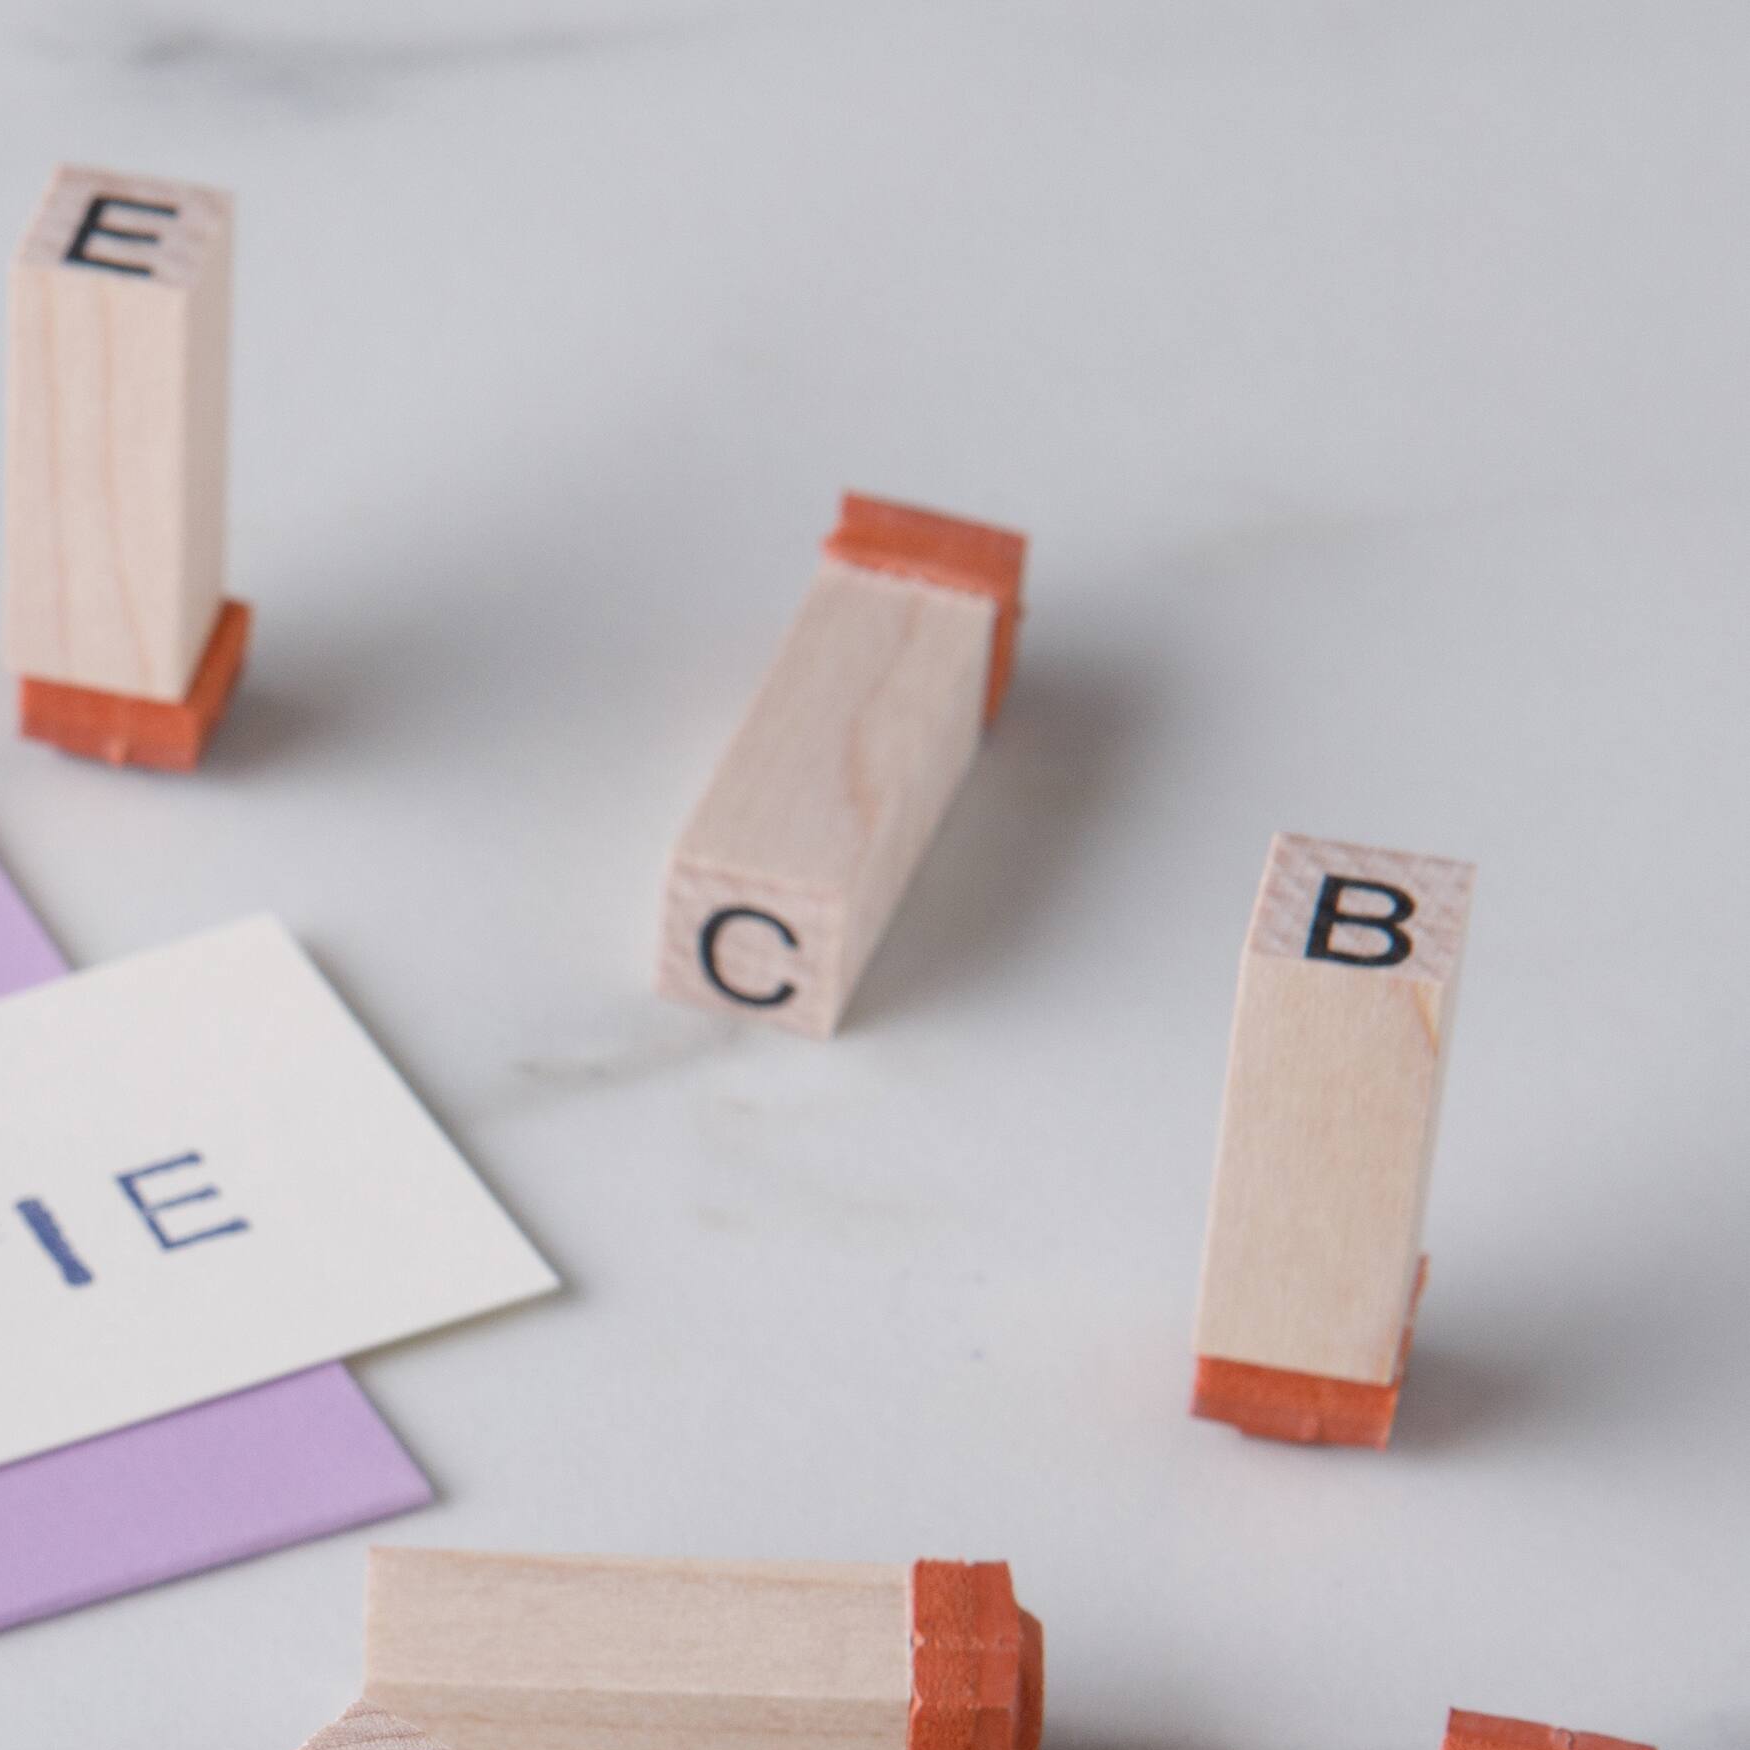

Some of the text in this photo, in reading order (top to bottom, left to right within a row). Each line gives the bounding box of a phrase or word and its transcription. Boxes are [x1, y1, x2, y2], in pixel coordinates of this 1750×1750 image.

[65, 195, 176, 276] E
[700, 907, 797, 1007] C
[1306, 876, 1414, 966] B
